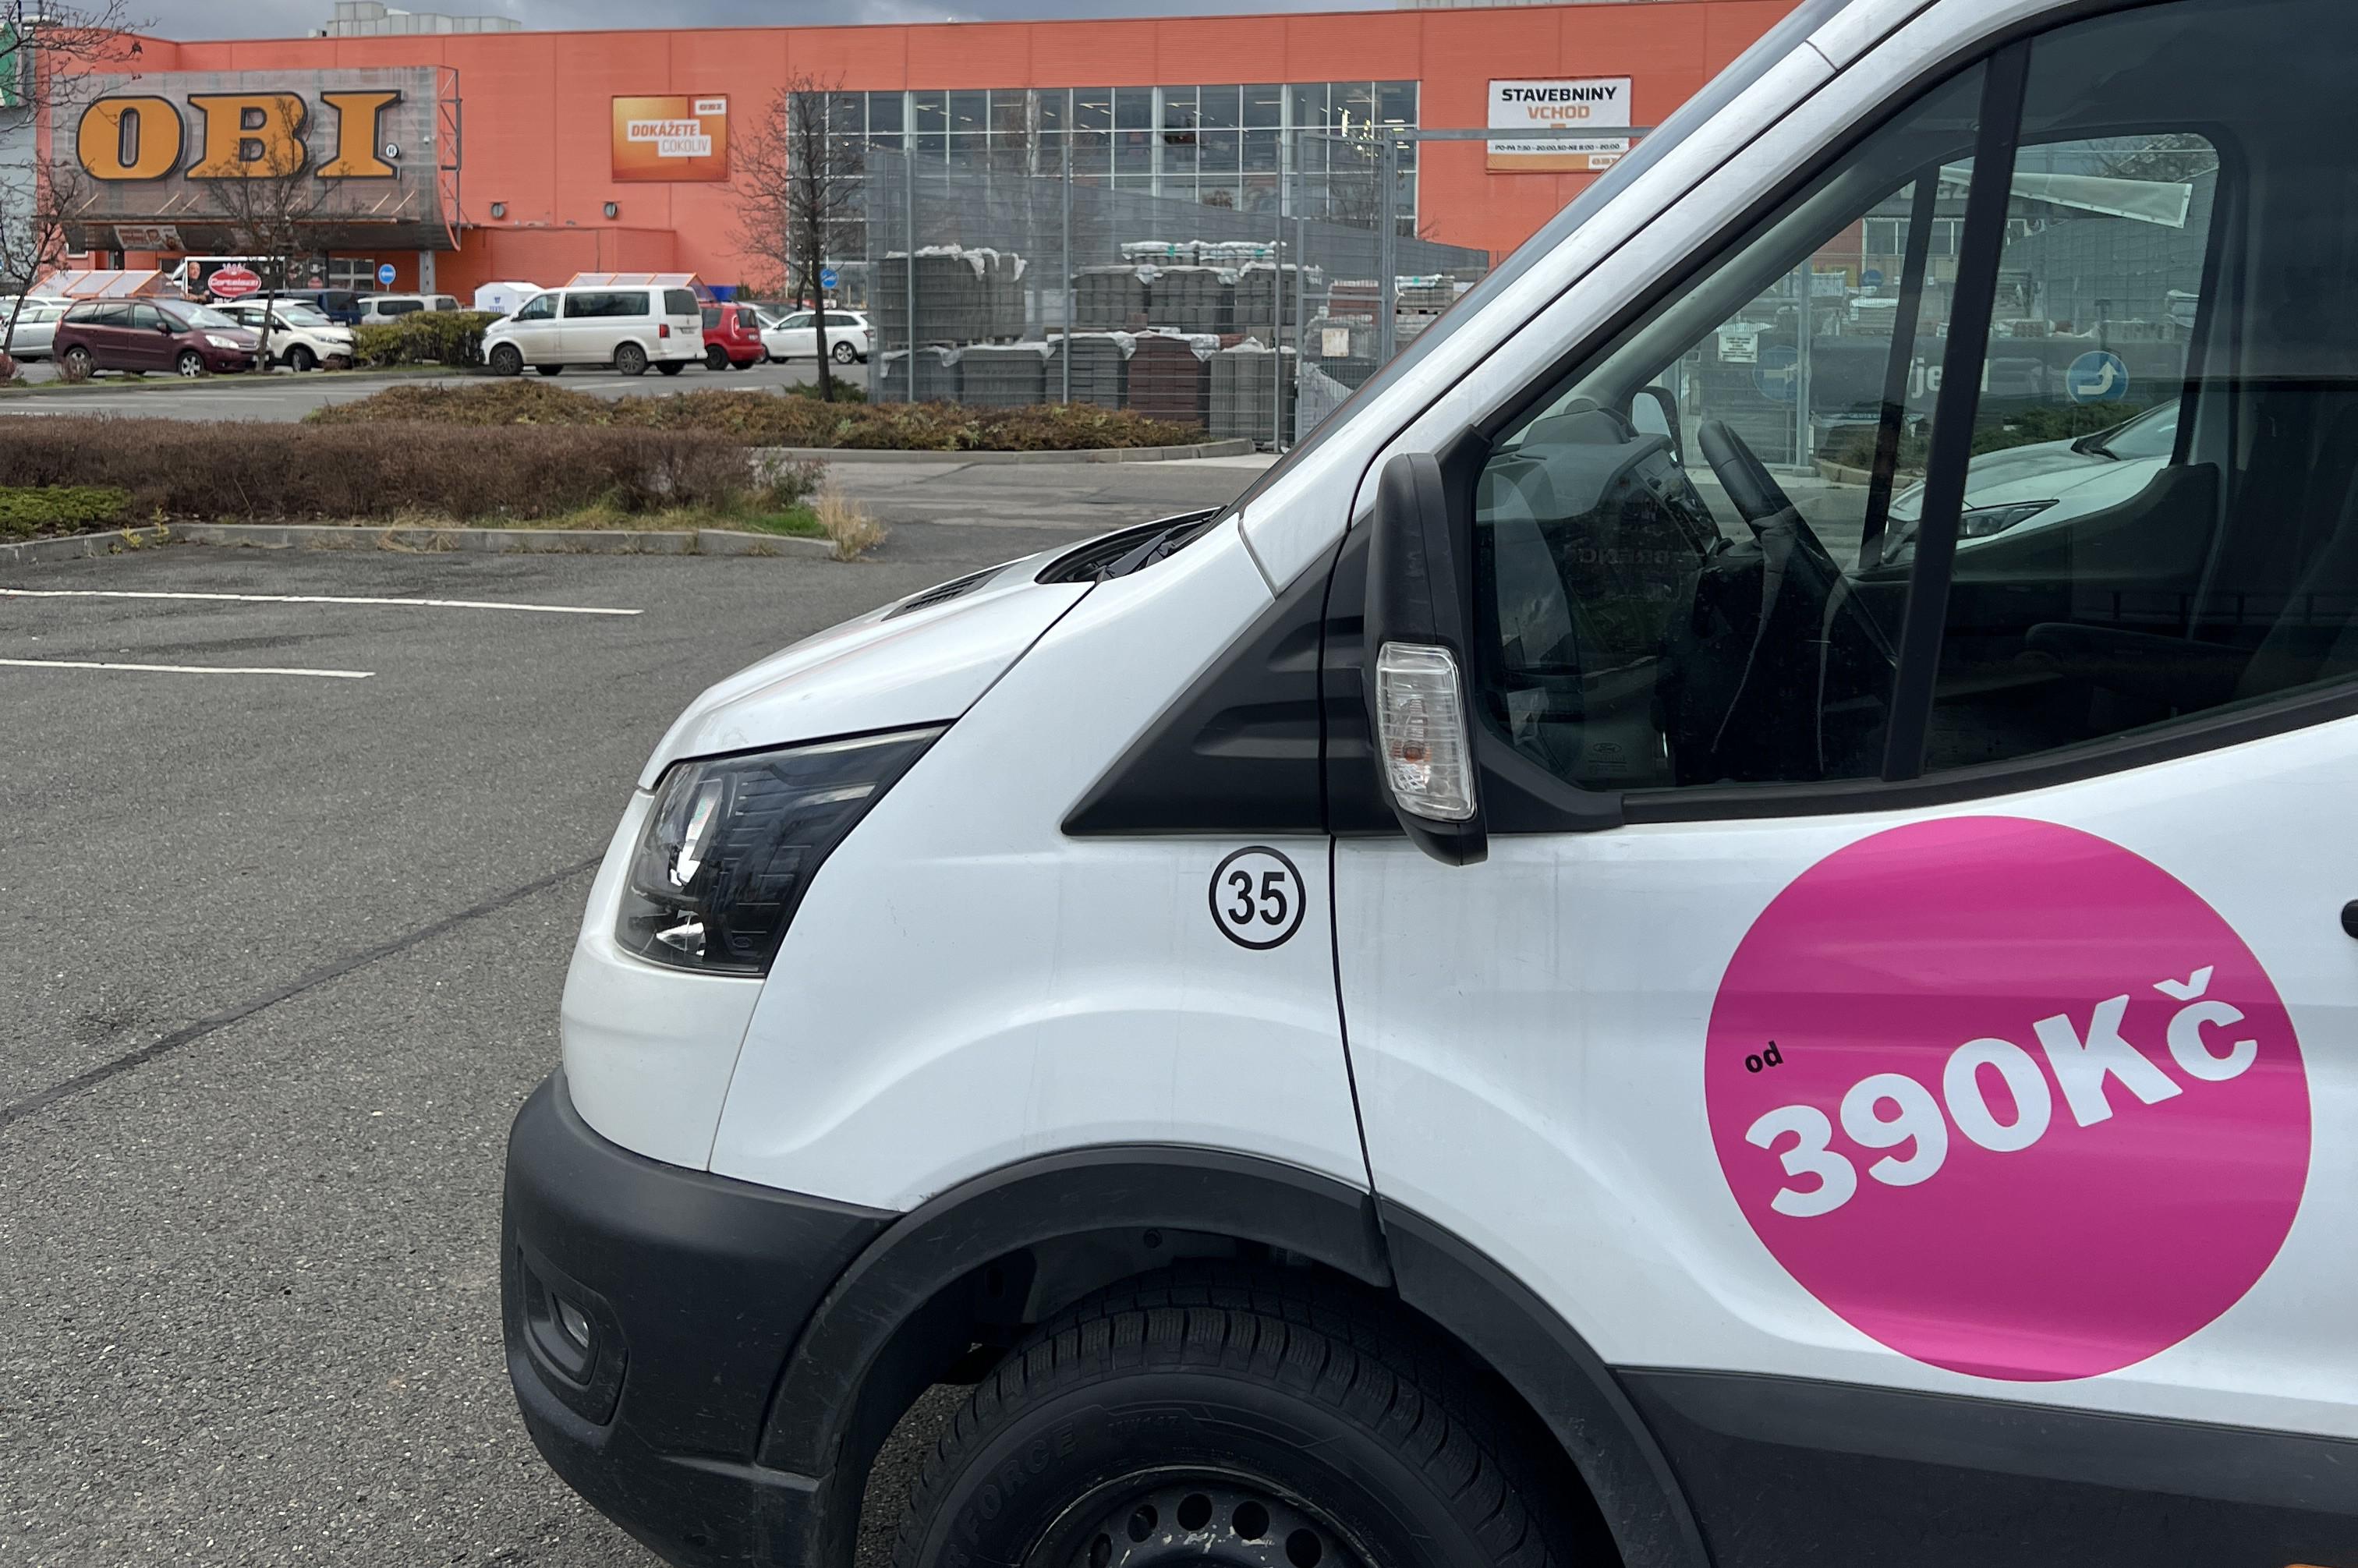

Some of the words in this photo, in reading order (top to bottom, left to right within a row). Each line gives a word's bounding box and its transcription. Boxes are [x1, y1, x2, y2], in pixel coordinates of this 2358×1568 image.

[1502, 86, 1617, 101] STAVEBNINY
[1527, 104, 1591, 119] VCHOD
[77, 90, 402, 180] OBI
[631, 120, 697, 137] DOKÁŽETE
[662, 139, 708, 153] COKOLIV
[1227, 869, 1287, 926] 35
[1744, 1040, 1784, 1074] od
